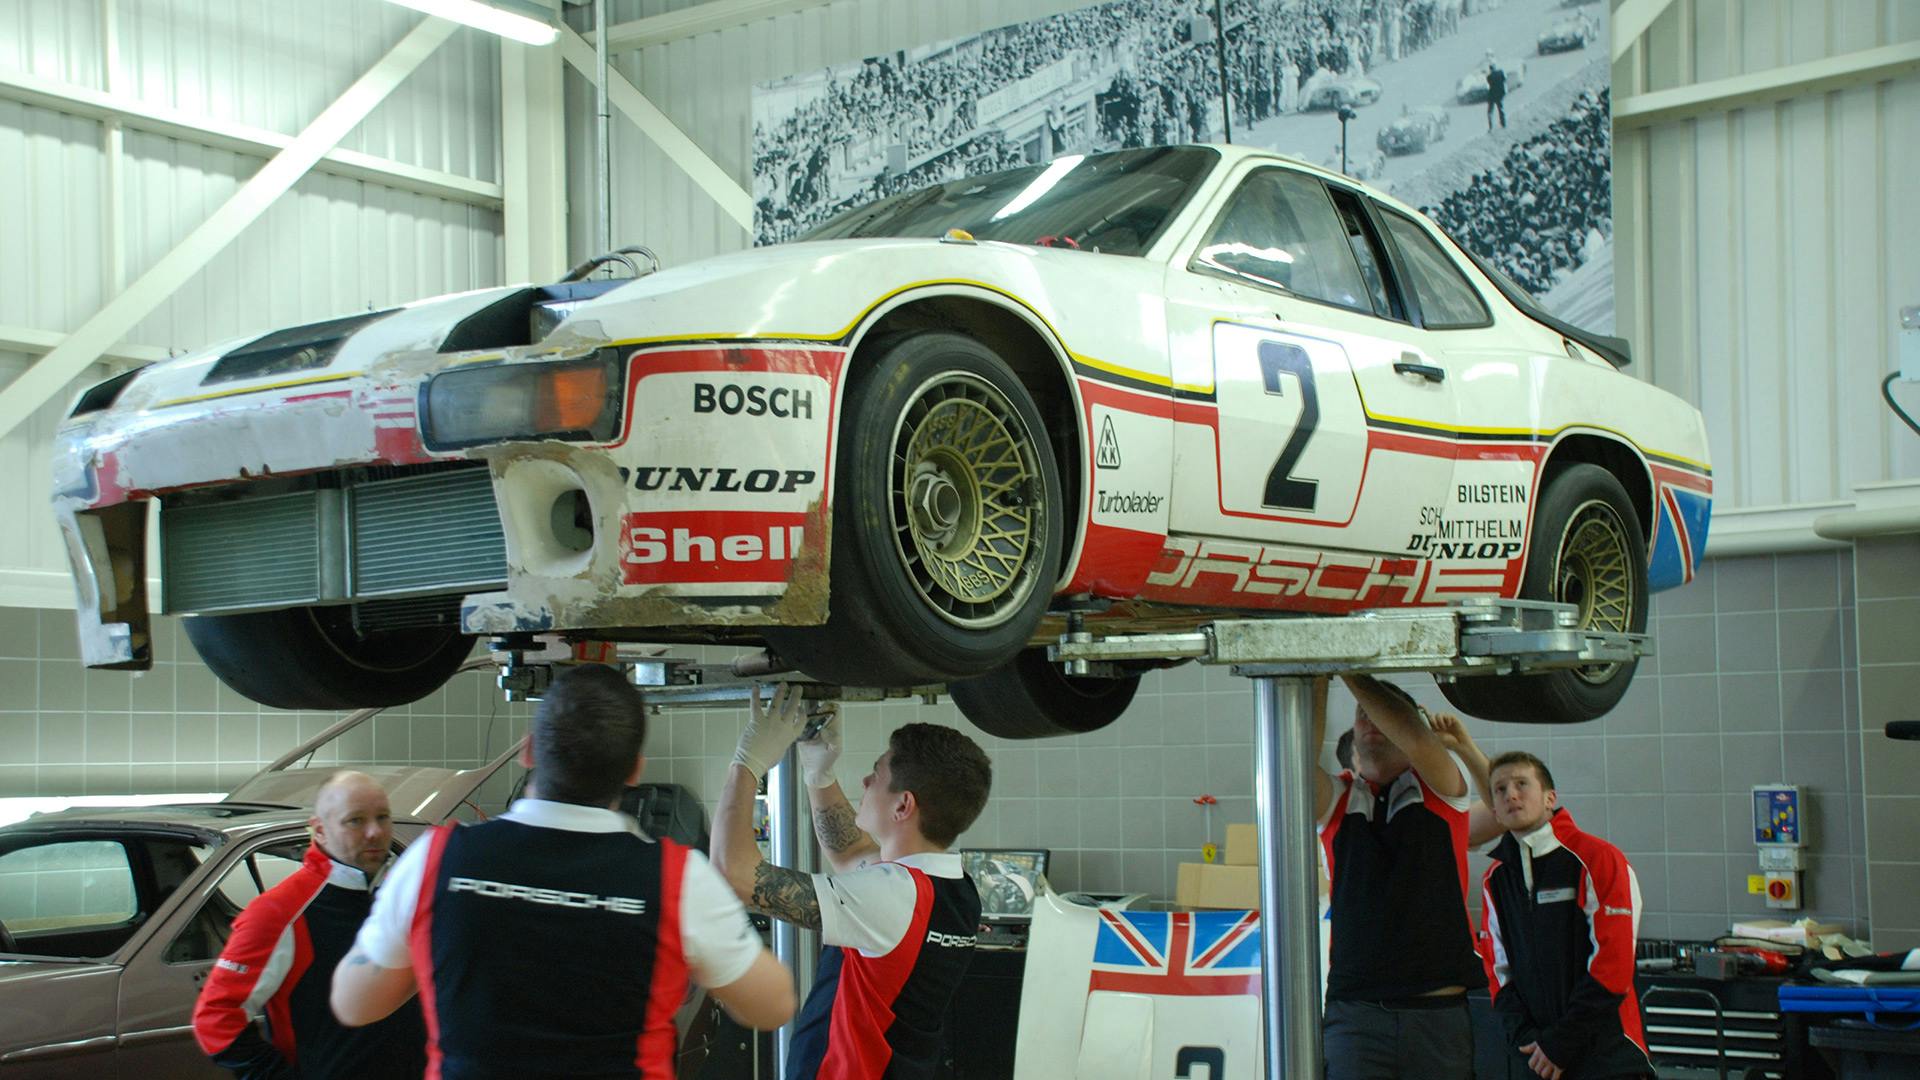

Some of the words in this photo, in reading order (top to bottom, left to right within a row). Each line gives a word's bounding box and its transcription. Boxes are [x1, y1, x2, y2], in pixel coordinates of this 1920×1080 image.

[694, 383, 812, 419] BOSCH
[1258, 340, 1321, 513] 2
[1098, 490, 1164, 513] Turbolader
[1457, 485, 1526, 503] BILSTEIN
[626, 526, 804, 564] Shell
[1406, 534, 1521, 559] DUNLOP
[960, 570, 990, 589] BBS
[448, 877, 646, 914] PORSCHE
